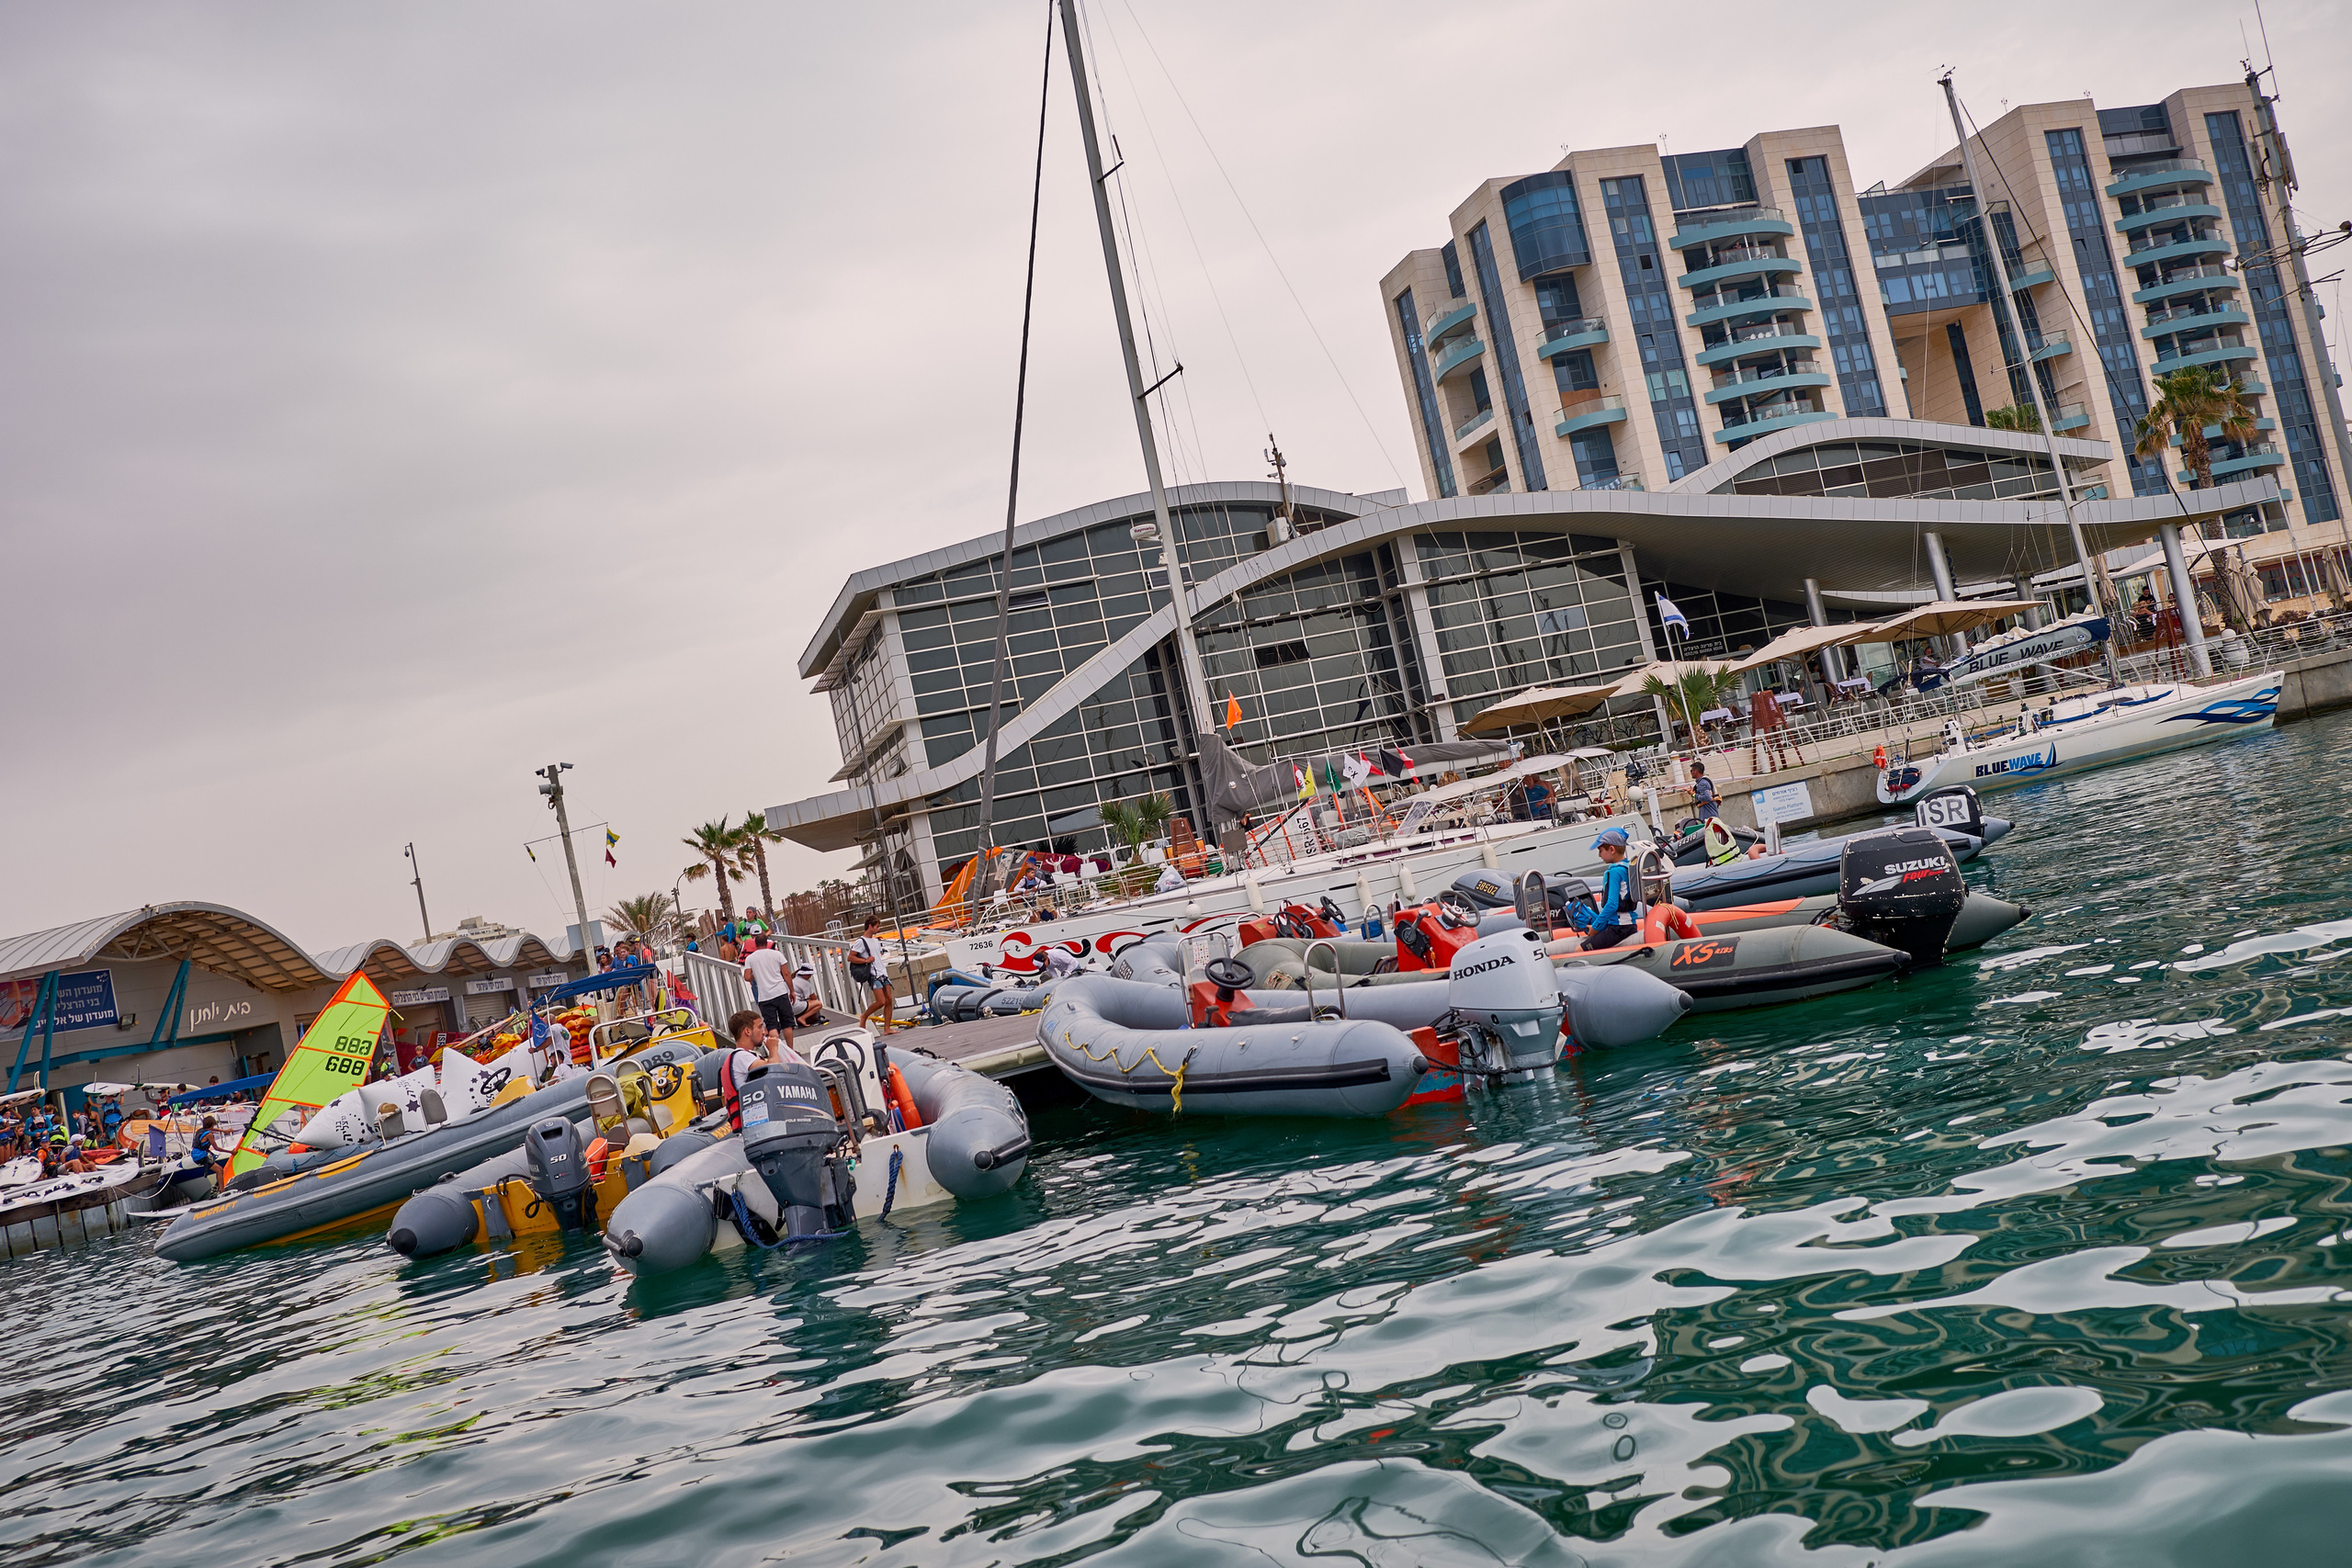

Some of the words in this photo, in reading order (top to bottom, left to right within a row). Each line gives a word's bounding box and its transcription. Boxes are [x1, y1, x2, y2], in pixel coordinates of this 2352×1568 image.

[1969, 651, 2008, 673] BLUE
[2019, 640, 2064, 658] WAVE
[1975, 752, 2043, 777] BLUEWAVE
[1920, 798, 1966, 826] ISR
[1883, 856, 1945, 874] SUZUKI
[1476, 881, 1498, 896] 38502
[968, 941, 994, 951] 72636
[1672, 942, 1718, 966] XS
[1453, 955, 1516, 981] HONDA
[74, 985, 103, 998] מועדון
[394, 992, 413, 1003] הרצליה
[87, 998, 100, 1007] בני
[223, 1001, 251, 1021] בית
[69, 1013, 83, 1023] של
[85, 1010, 114, 1023] מועדון
[325, 1056, 366, 1077] 688
[742, 1089, 764, 1106] 50
[777, 1086, 818, 1100] YAMAHA
[549, 1154, 568, 1165] 50
[193, 1200, 238, 1222] RIBCRAFT
